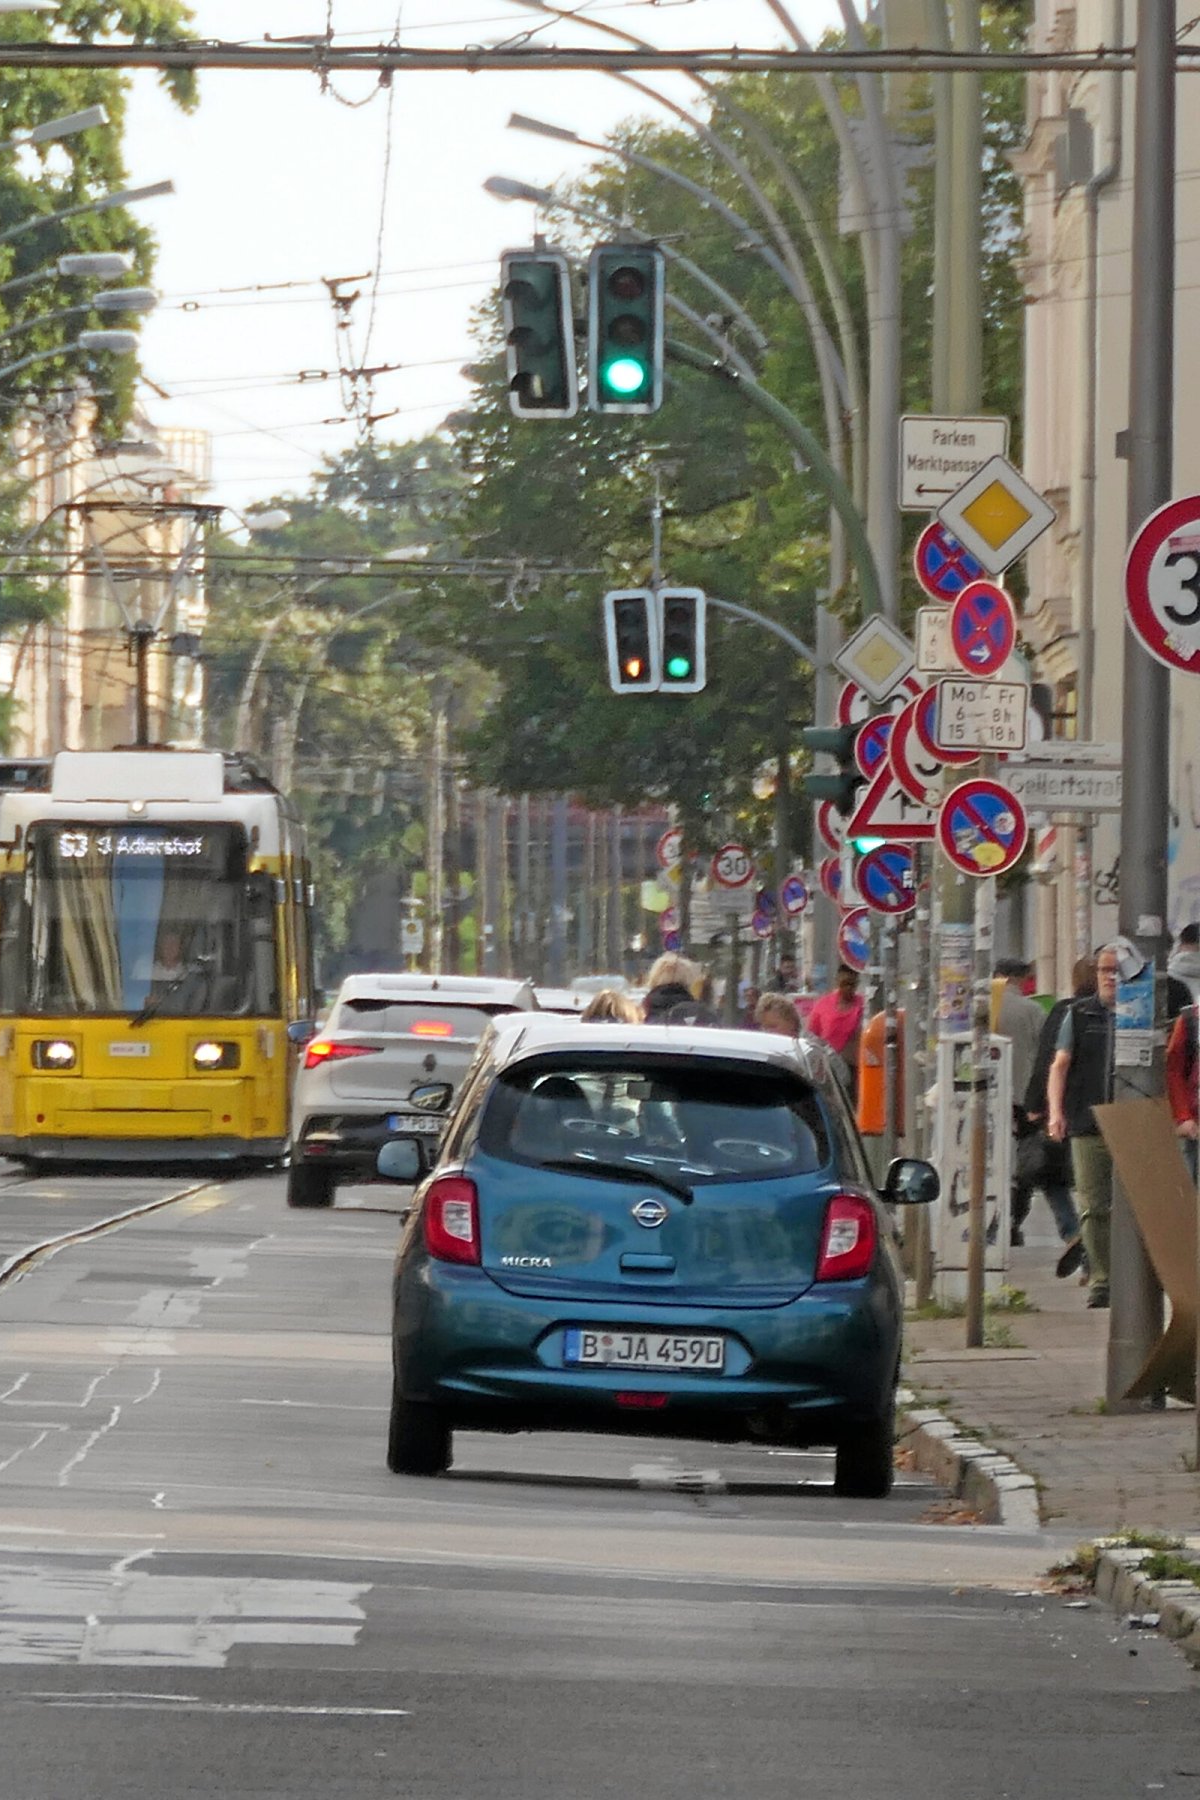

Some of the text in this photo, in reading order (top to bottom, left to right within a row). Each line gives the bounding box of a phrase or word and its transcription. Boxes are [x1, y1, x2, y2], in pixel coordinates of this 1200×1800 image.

[932, 429, 976, 447] Parken
[907, 454, 984, 474] Marktpassa
[951, 686, 976, 702] Mo
[999, 688, 1016, 704] Fr
[956, 707, 965, 721] 6
[948, 723, 965, 740] 15
[721, 855, 747, 876] 30
[501, 1256, 552, 1268] MICRA
[582, 1334, 721, 1365] B JA 4590
